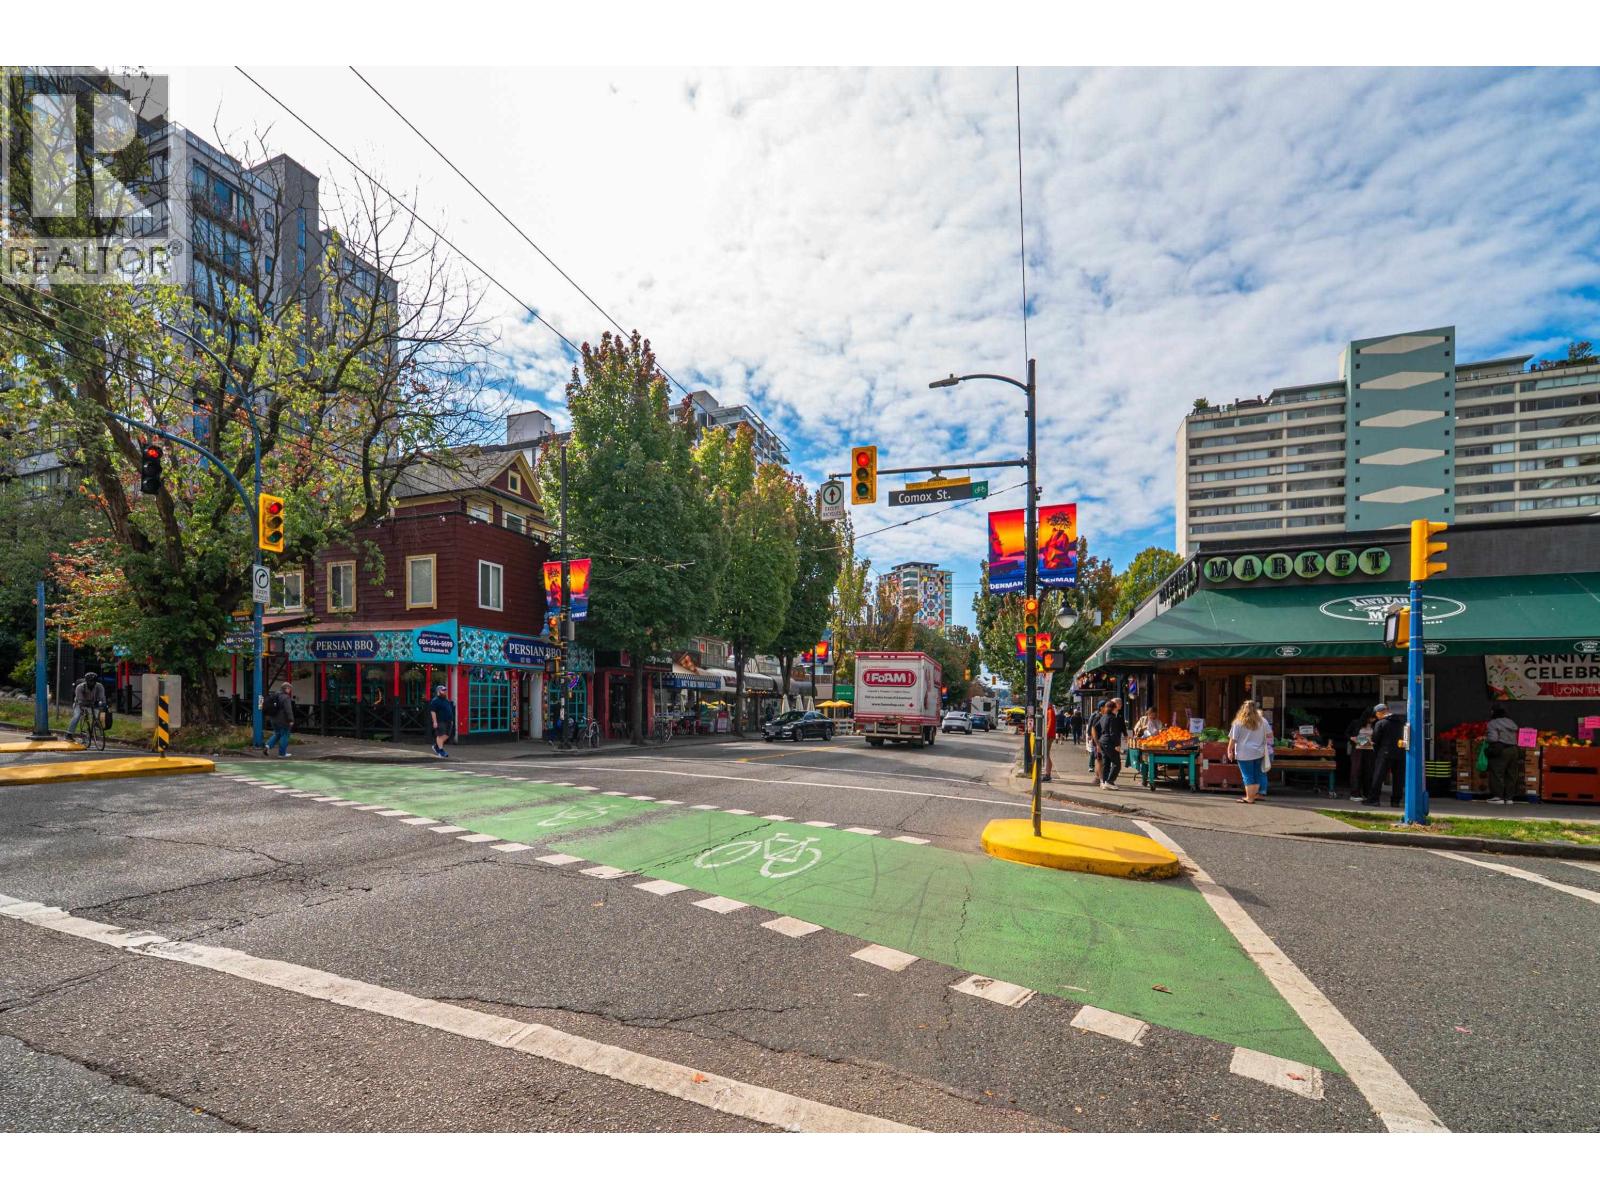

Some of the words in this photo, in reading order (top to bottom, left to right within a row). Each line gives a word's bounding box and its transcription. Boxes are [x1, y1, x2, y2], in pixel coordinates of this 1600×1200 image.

[898, 491, 931, 504] Comox
[936, 489, 951, 501] St.
[1208, 550, 1386, 577] MARKET
[989, 581, 1024, 590] DENMAN
[1384, 596, 1409, 604] FAR
[316, 640, 353, 651] PERSIAN
[354, 640, 375, 652] BBQ
[509, 643, 544, 657] PERSIAN
[1558, 687, 1583, 695] JOIN
